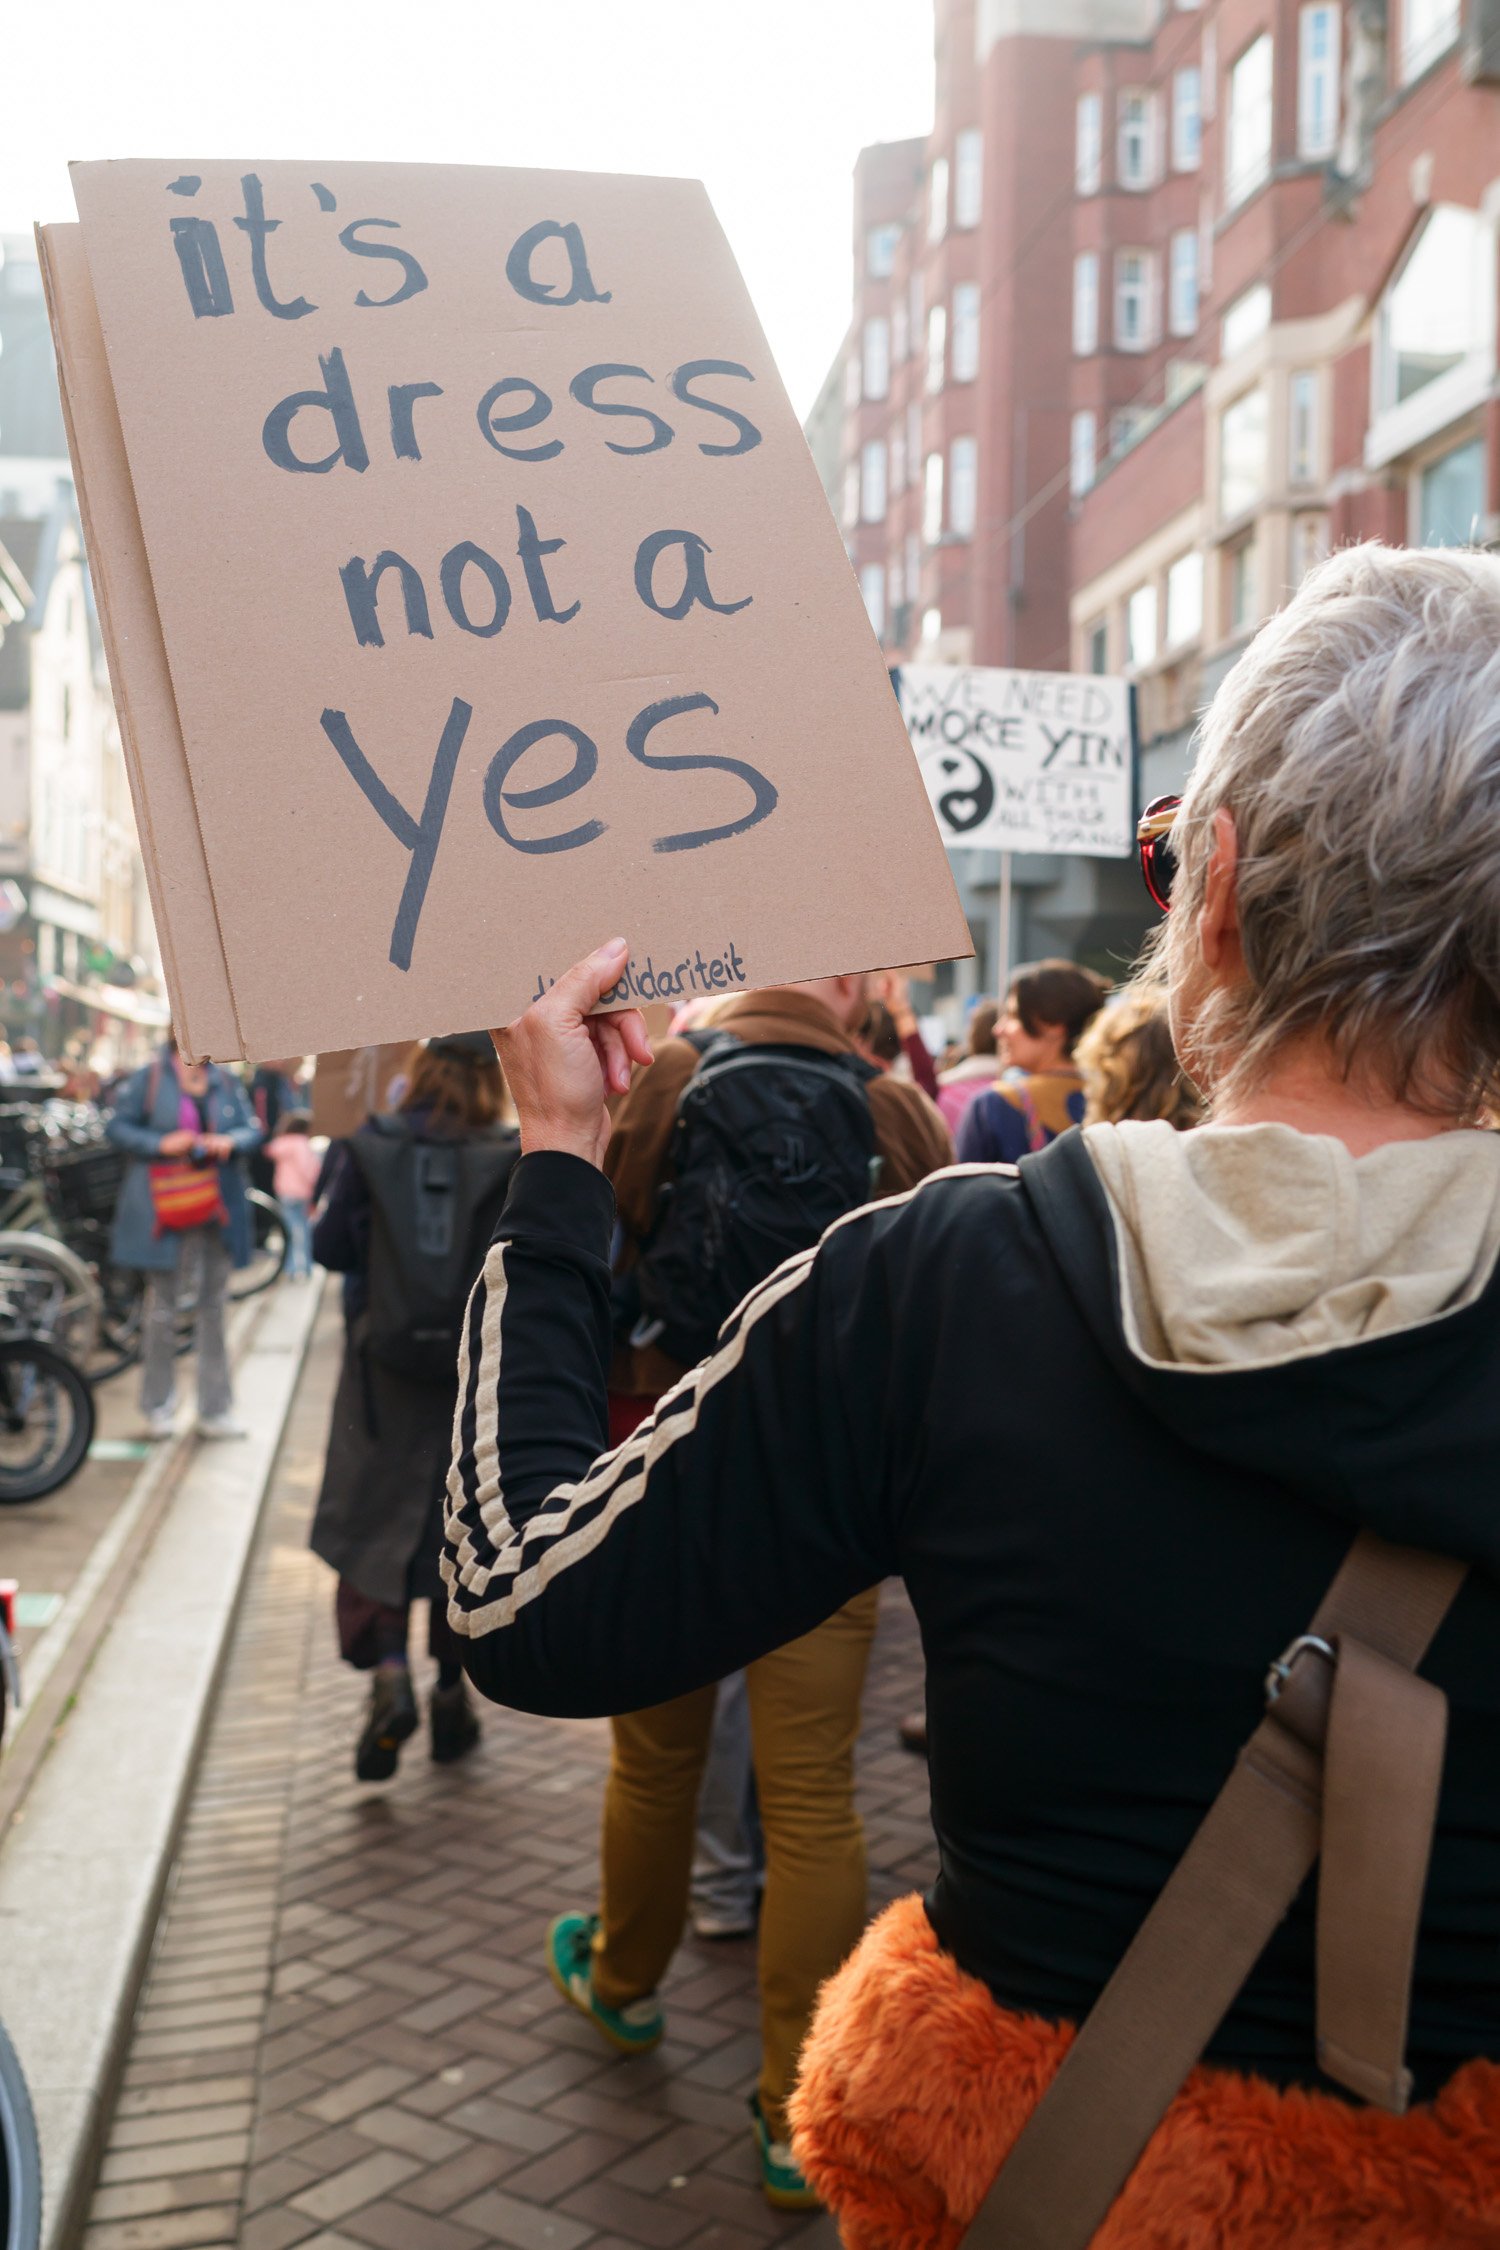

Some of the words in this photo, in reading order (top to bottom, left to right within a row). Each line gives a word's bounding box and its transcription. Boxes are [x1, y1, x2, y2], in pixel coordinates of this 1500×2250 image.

[166, 172, 429, 320] it's
[505, 219, 612, 306] a
[262, 346, 762, 474] dress
[338, 503, 581, 648] not
[633, 529, 753, 621] a
[902, 669, 985, 708] WE
[1002, 677, 1114, 726] NEED
[908, 707, 1024, 752] MORE
[1037, 722, 1124, 769] YIN
[319, 691, 779, 973] yes
